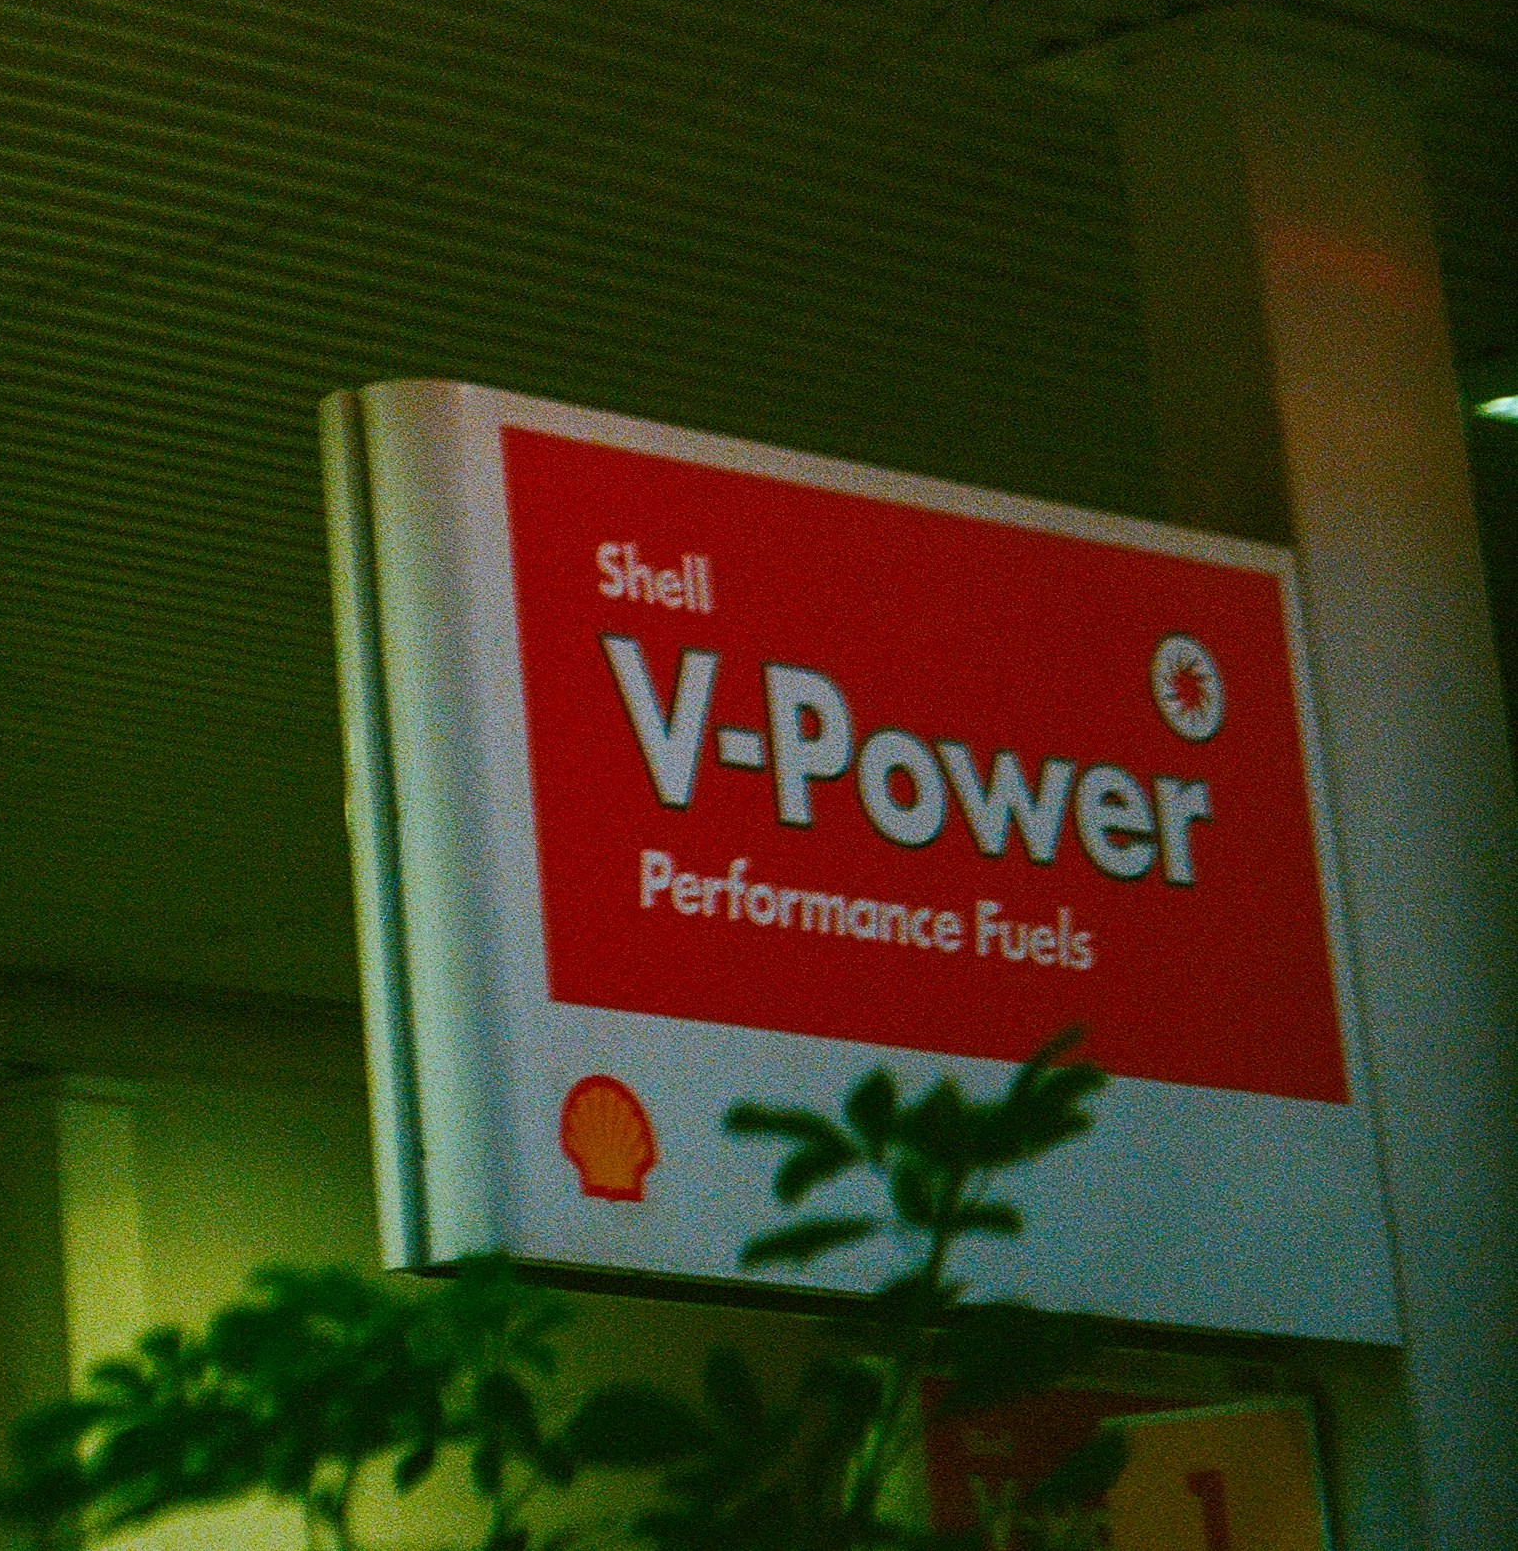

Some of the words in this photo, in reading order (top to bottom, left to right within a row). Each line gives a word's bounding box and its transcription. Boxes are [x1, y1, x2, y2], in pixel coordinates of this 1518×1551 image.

[595, 541, 714, 614] Shell
[598, 632, 1215, 889] V-Power
[639, 847, 964, 956] Performance
[973, 899, 1096, 971] Fuels
